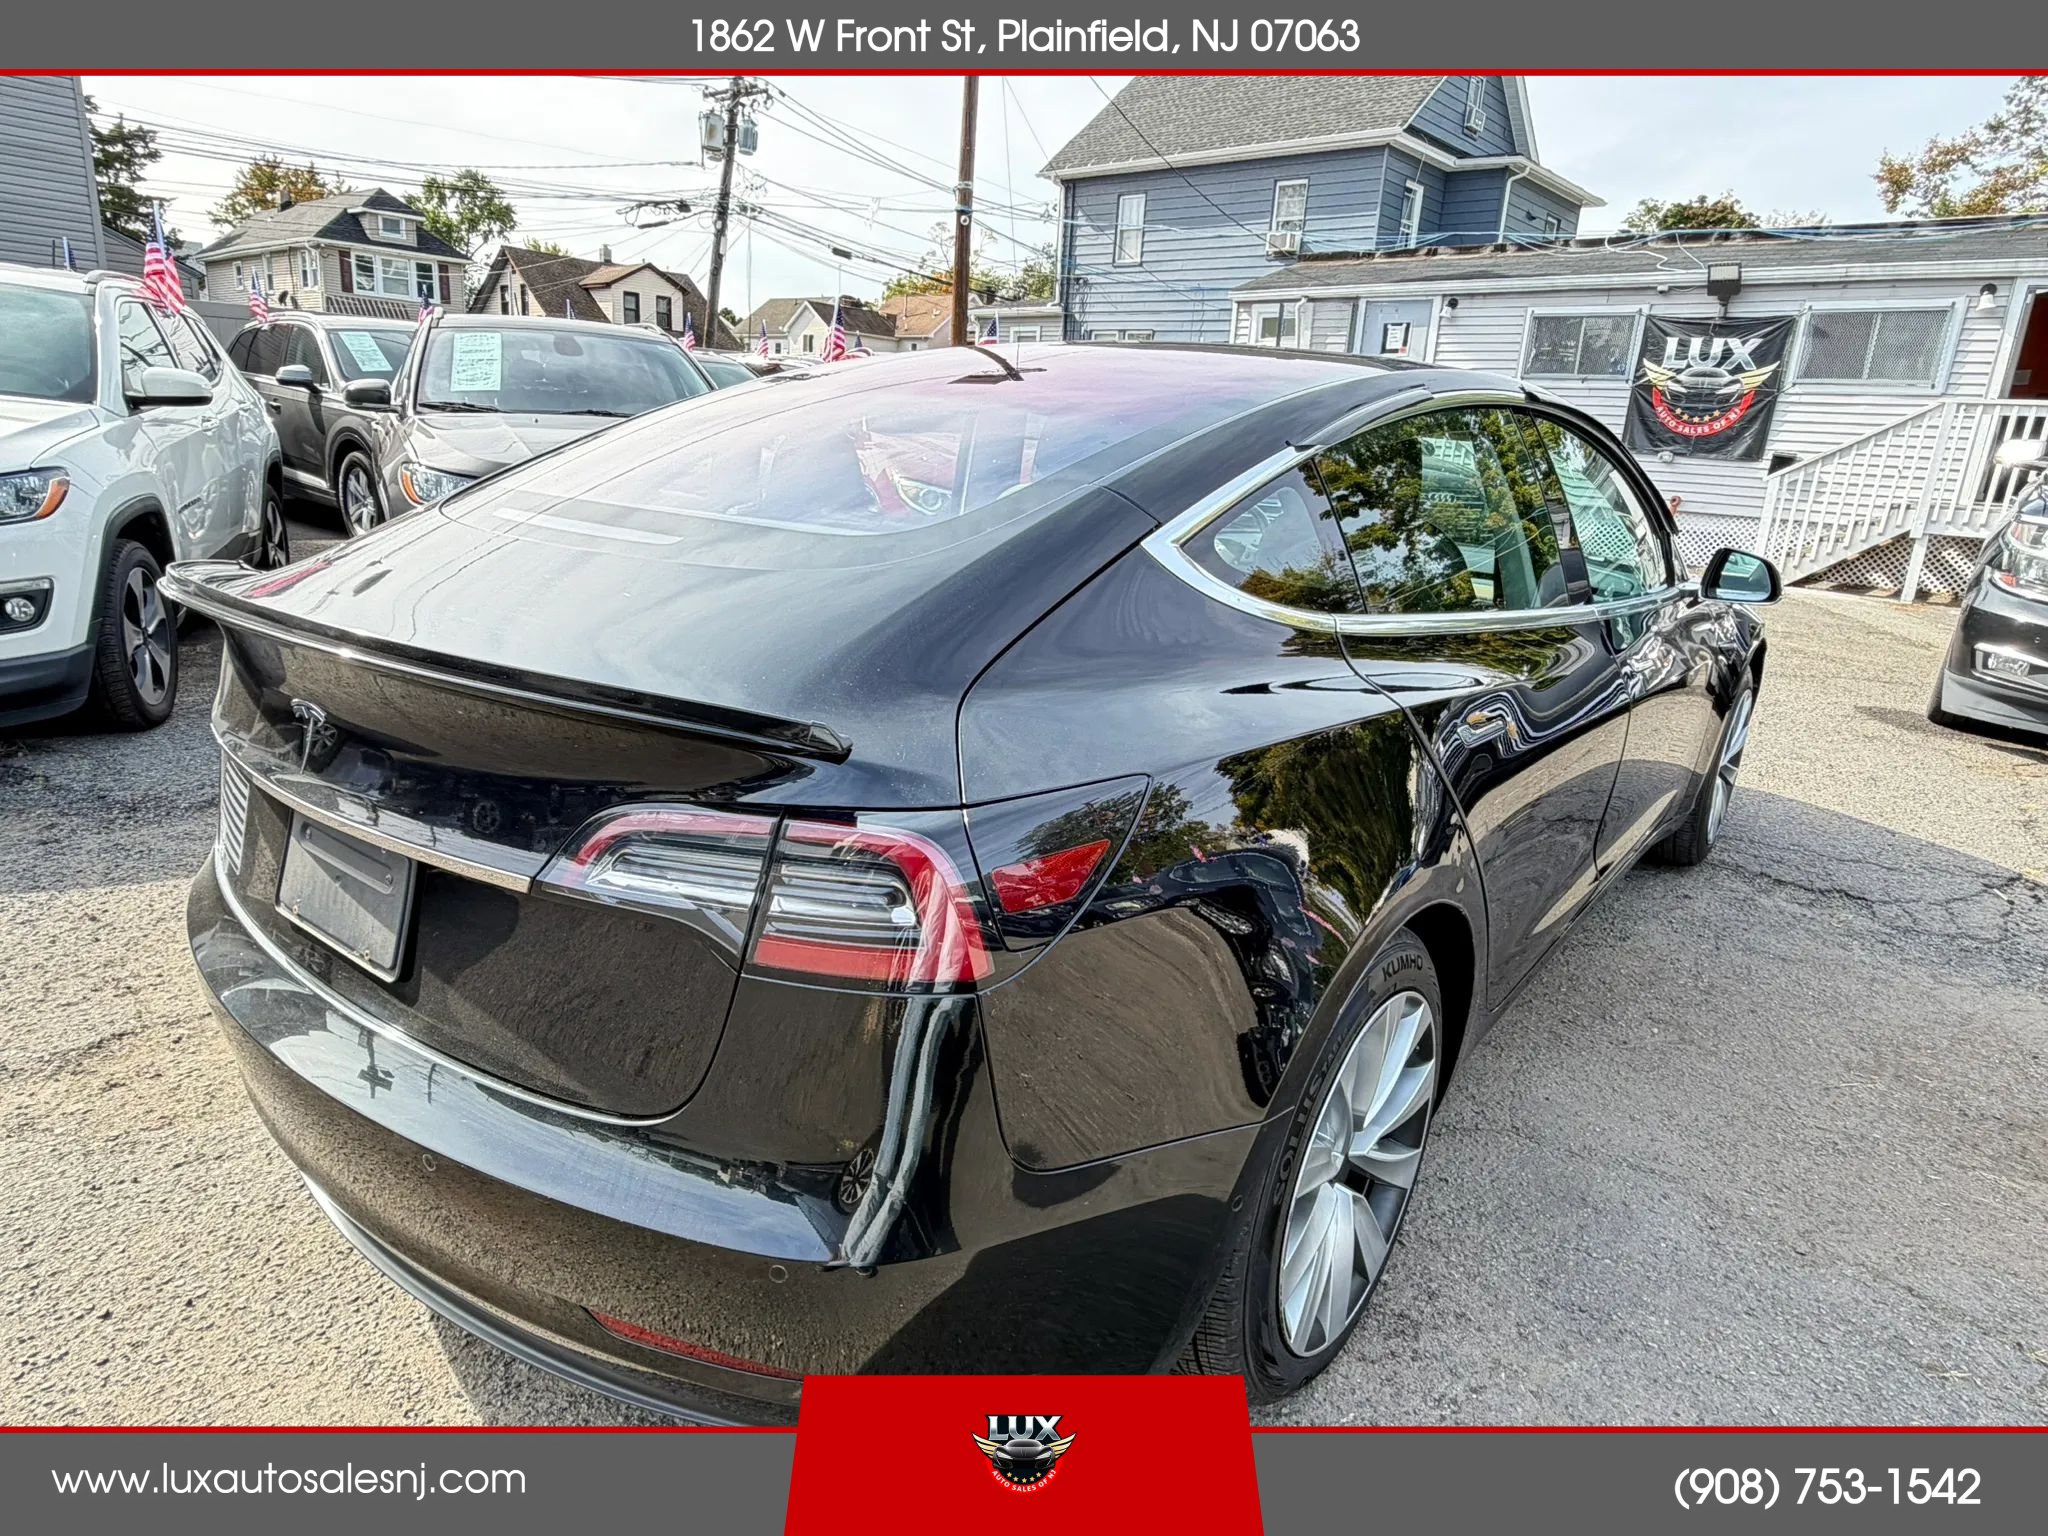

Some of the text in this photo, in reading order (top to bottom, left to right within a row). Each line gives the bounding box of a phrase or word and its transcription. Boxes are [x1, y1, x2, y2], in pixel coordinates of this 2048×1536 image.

[1661, 336, 1764, 370] LUX
[1655, 406, 1741, 435] AUTO SALES OF NJ
[1382, 953, 1423, 982] KUMHO
[1273, 1073, 1322, 1205] SOLUS
